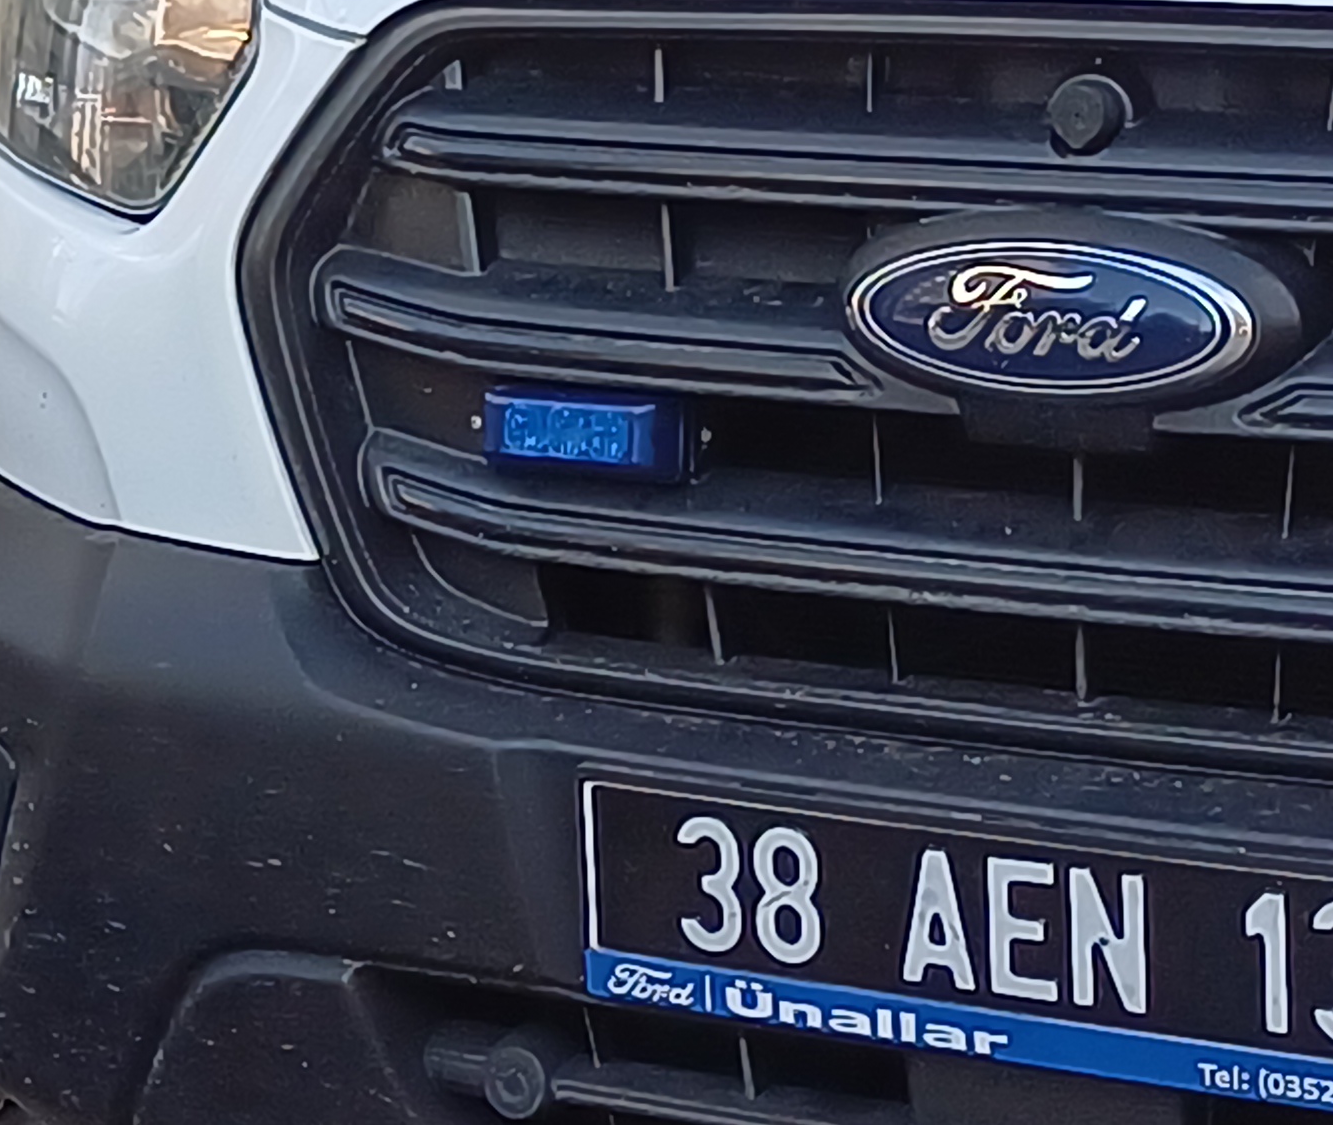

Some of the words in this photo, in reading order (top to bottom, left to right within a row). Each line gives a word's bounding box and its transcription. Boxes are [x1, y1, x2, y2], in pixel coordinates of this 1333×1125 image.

[927, 265, 1147, 363] Ford
[677, 816, 821, 964] 38
[903, 849, 1147, 1014] AEN
[607, 963, 695, 1006] Ford
[724, 979, 1009, 1056] Ünallar
[1197, 1062, 1250, 1091] Tel:
